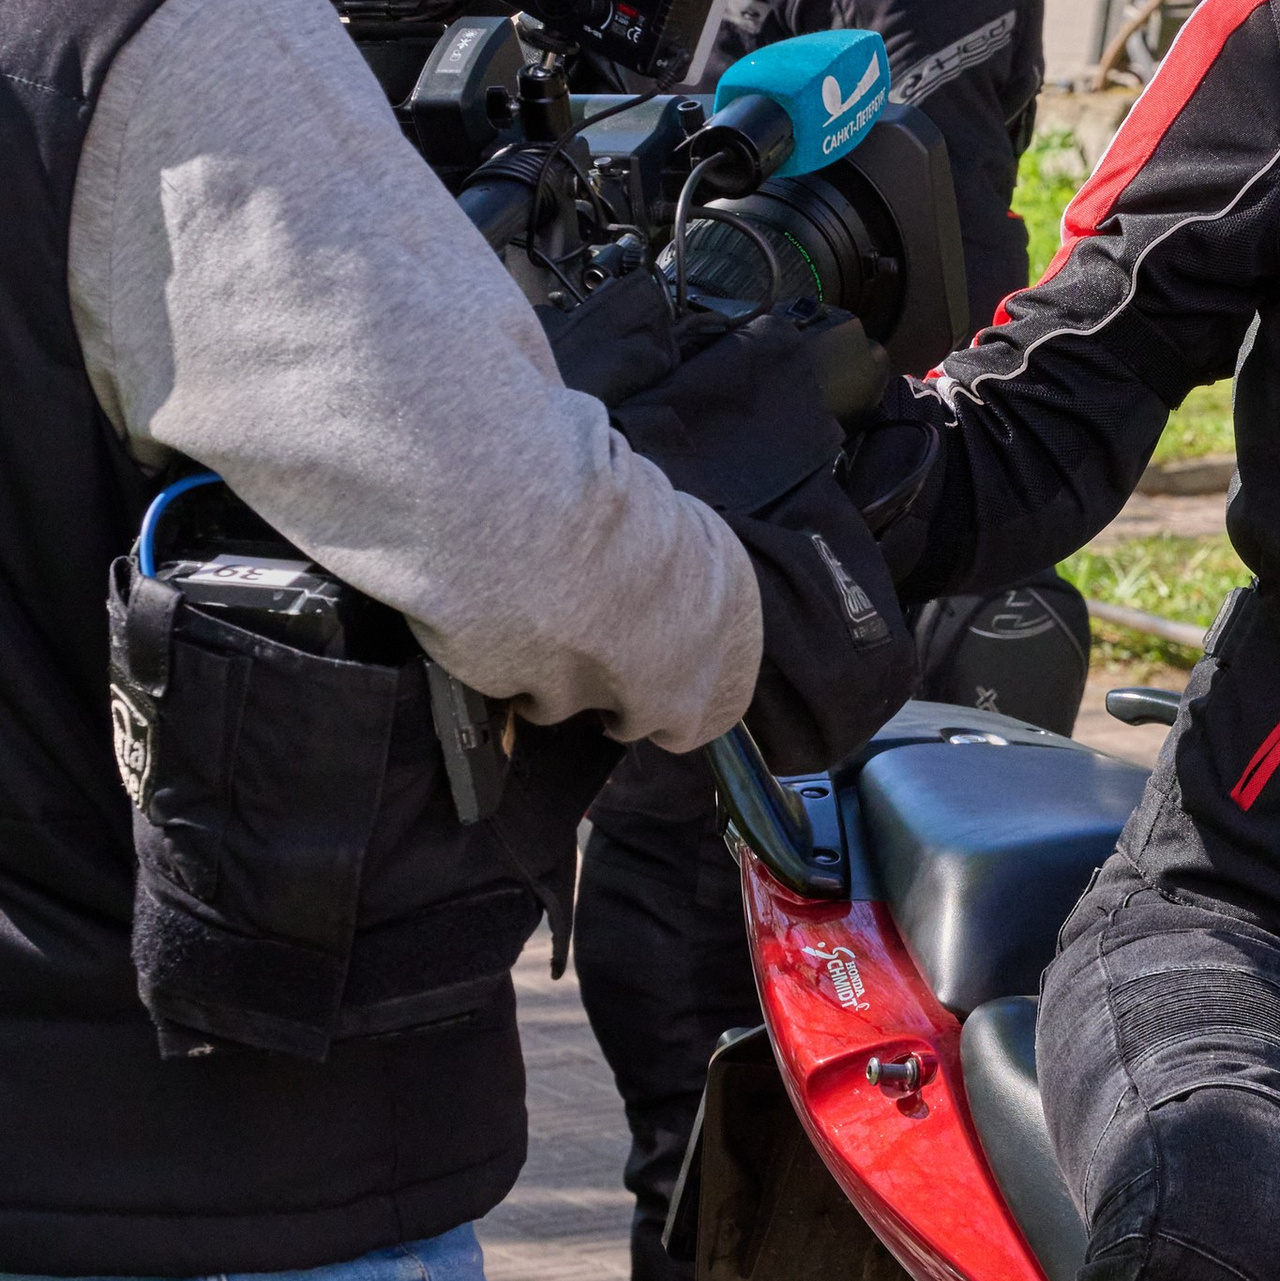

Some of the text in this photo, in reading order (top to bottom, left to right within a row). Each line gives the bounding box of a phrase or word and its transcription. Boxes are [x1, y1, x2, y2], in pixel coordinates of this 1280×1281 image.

[822, 86, 886, 155] САНКТ-ПЕТЕРБУРГ
[784, 231, 811, 263] FUJINON
[845, 961, 865, 998] HONDA
